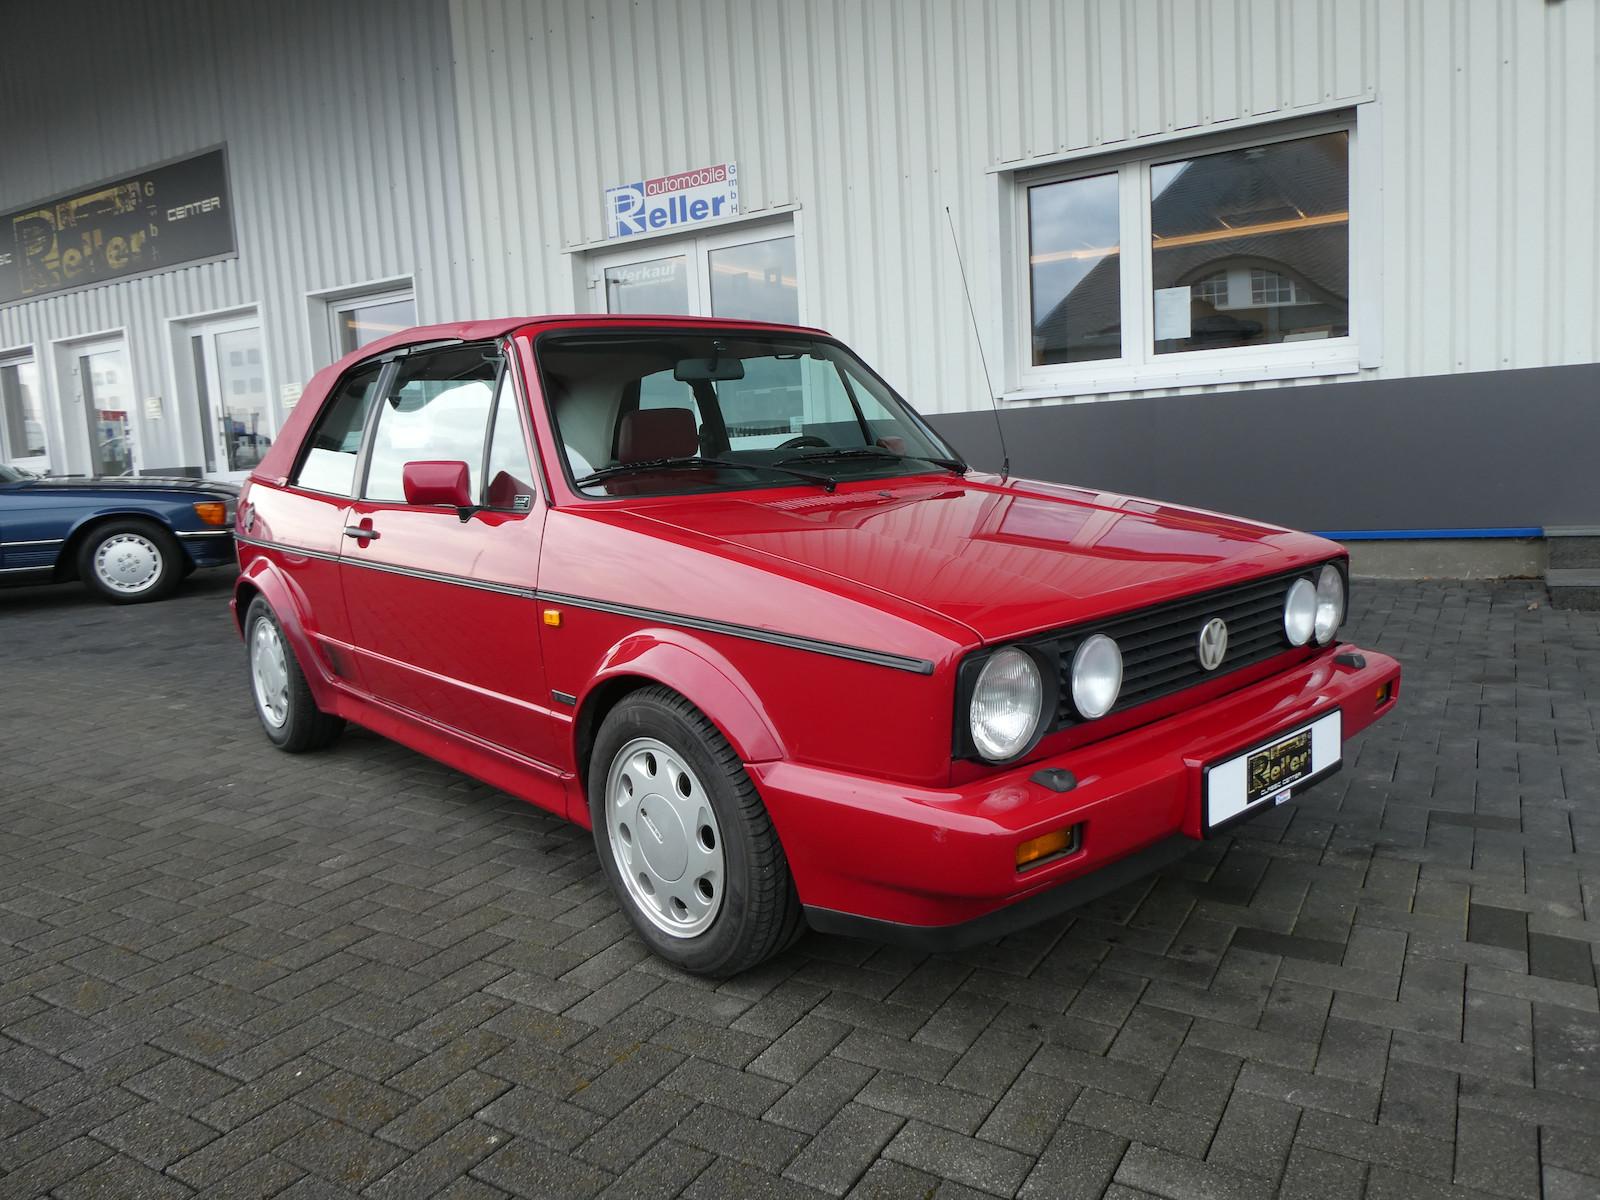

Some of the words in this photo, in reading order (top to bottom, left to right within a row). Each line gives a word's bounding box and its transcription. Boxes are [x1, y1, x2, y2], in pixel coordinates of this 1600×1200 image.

[647, 166, 726, 197] automobile
[167, 196, 221, 222] CENTER
[606, 183, 726, 238] Reller
